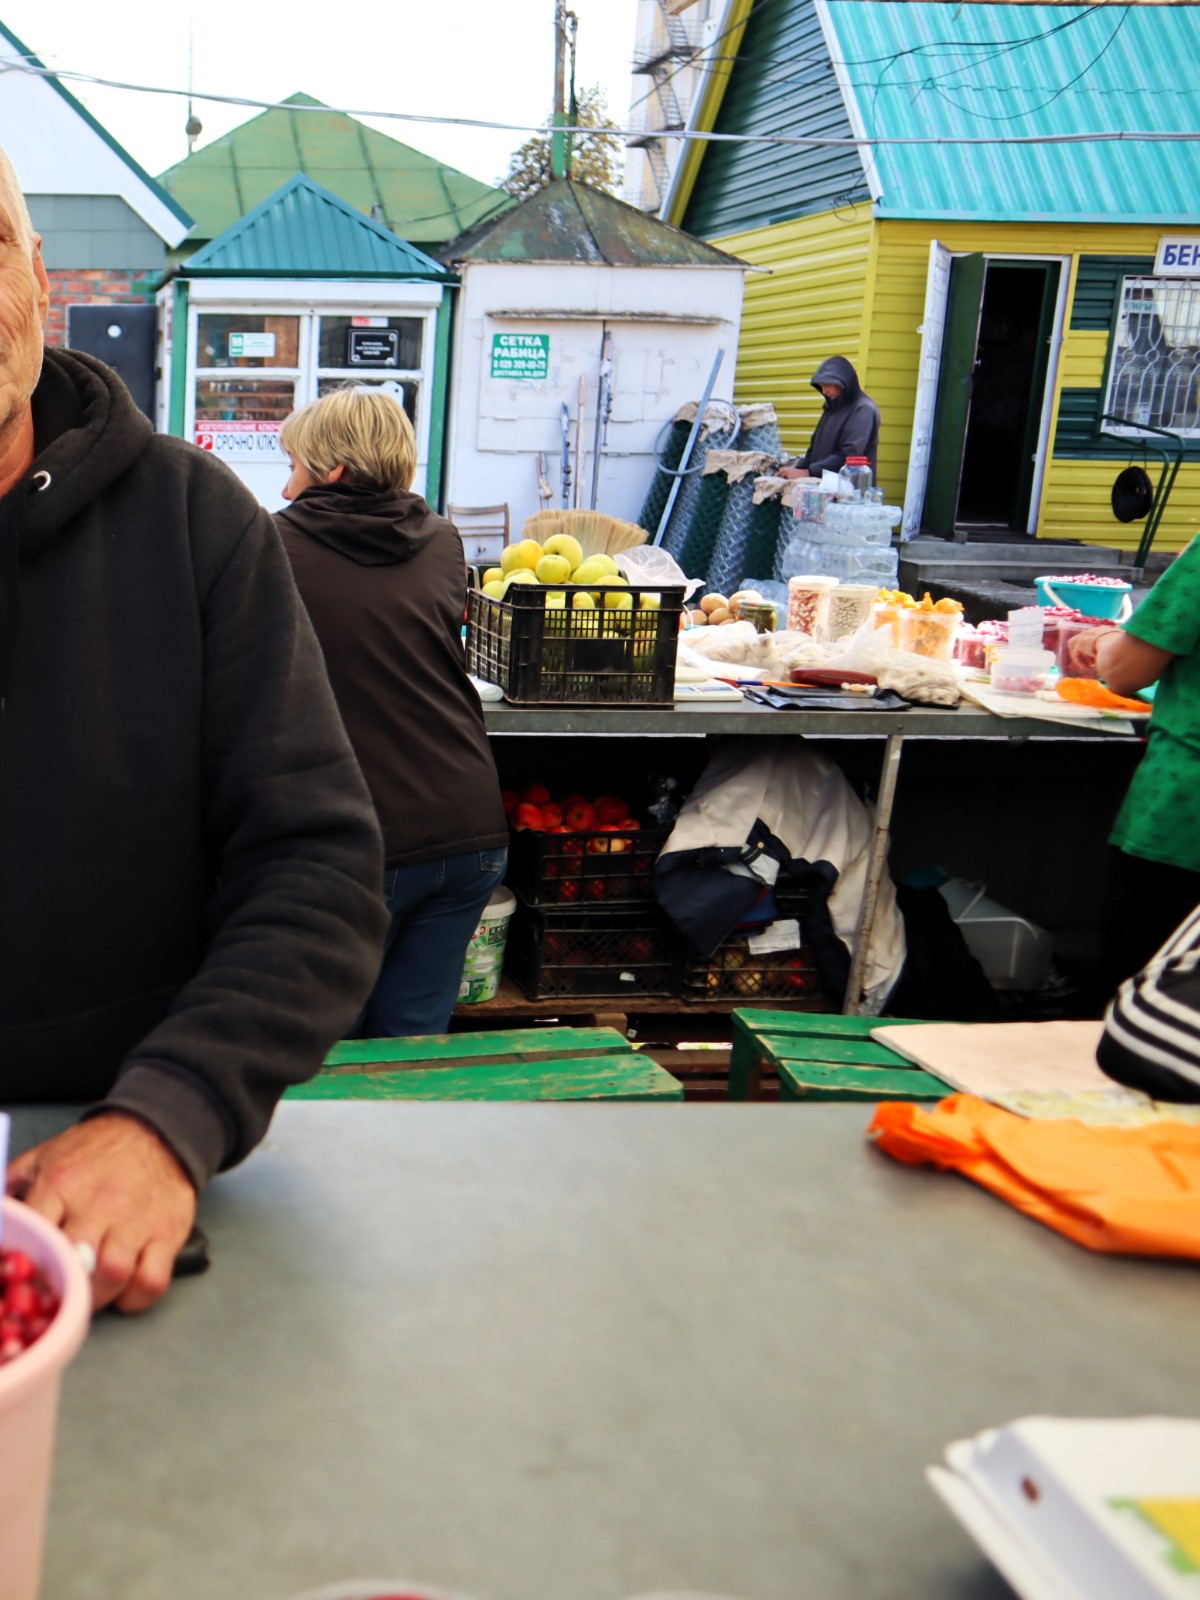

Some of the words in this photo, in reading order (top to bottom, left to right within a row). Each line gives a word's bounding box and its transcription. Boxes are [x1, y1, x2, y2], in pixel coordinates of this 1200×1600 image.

[500, 335, 543, 347] СЕТКА
[494, 347, 546, 360] РАБИЦА
[198, 422, 257, 432] ИЗГОТОВЛЕНИЕ
[215, 434, 254, 451] СРОЧНО
[256, 434, 280, 451] КЛЮ
